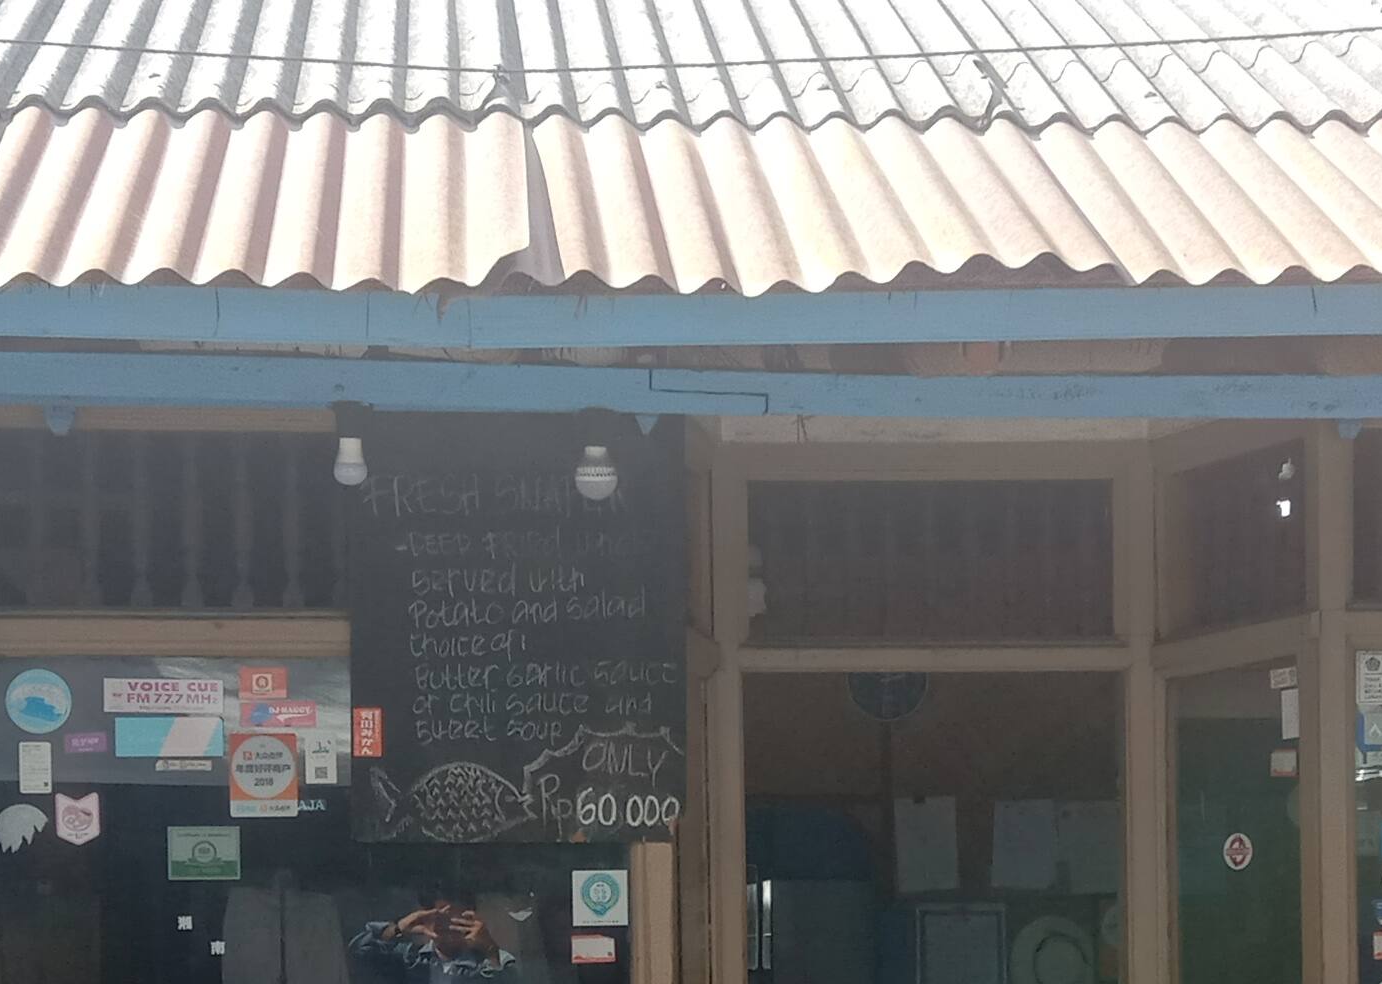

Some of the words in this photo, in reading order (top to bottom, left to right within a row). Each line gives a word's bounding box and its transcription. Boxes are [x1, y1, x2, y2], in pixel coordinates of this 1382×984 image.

[127, 681, 180, 693] VOICE
[186, 681, 219, 693] CUE
[127, 693, 151, 704] FM
[581, 740, 669, 788] ONLY
[539, 774, 571, 839] Rp
